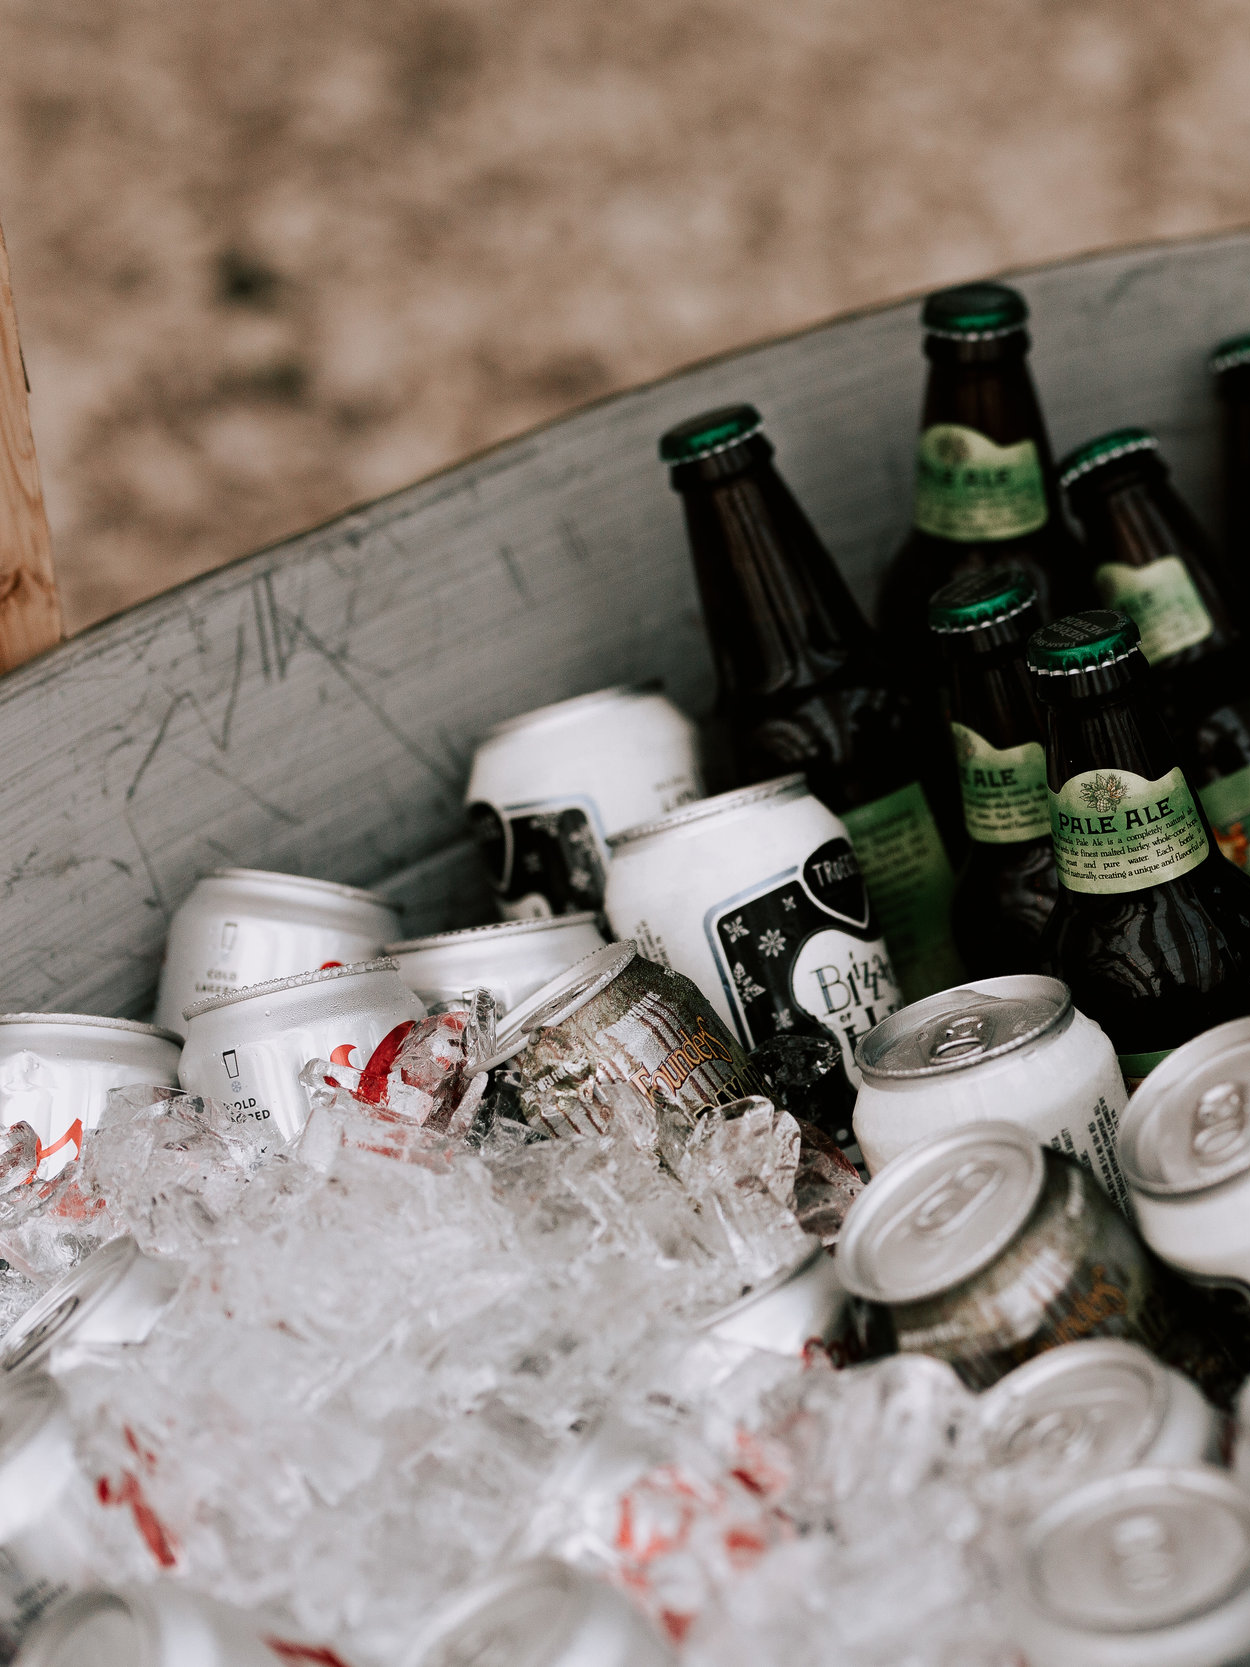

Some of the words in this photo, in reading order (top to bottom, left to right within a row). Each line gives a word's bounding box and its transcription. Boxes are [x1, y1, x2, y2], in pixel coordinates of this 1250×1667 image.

[973, 767, 1018, 788] ALE
[1058, 811, 1118, 835] PALE
[1124, 796, 1175, 831] ALE
[1076, 838, 1089, 846] Pale
[1093, 838, 1103, 847] Ale
[1108, 837, 1113, 845] is
[1127, 824, 1163, 842] completely
[1165, 810, 1186, 829] natural
[1081, 848, 1098, 858] finest
[1100, 846, 1126, 857] malted
[1084, 860, 1096, 869] and
[1103, 861, 1120, 870] pure
[1128, 854, 1150, 865] water.
[1155, 844, 1175, 858] Each
[1098, 871, 1126, 880] creating
[1134, 863, 1161, 876] unique
[1161, 855, 1175, 867] and
[1174, 840, 1200, 862] flavorful
[629, 1014, 734, 1113] Founders
